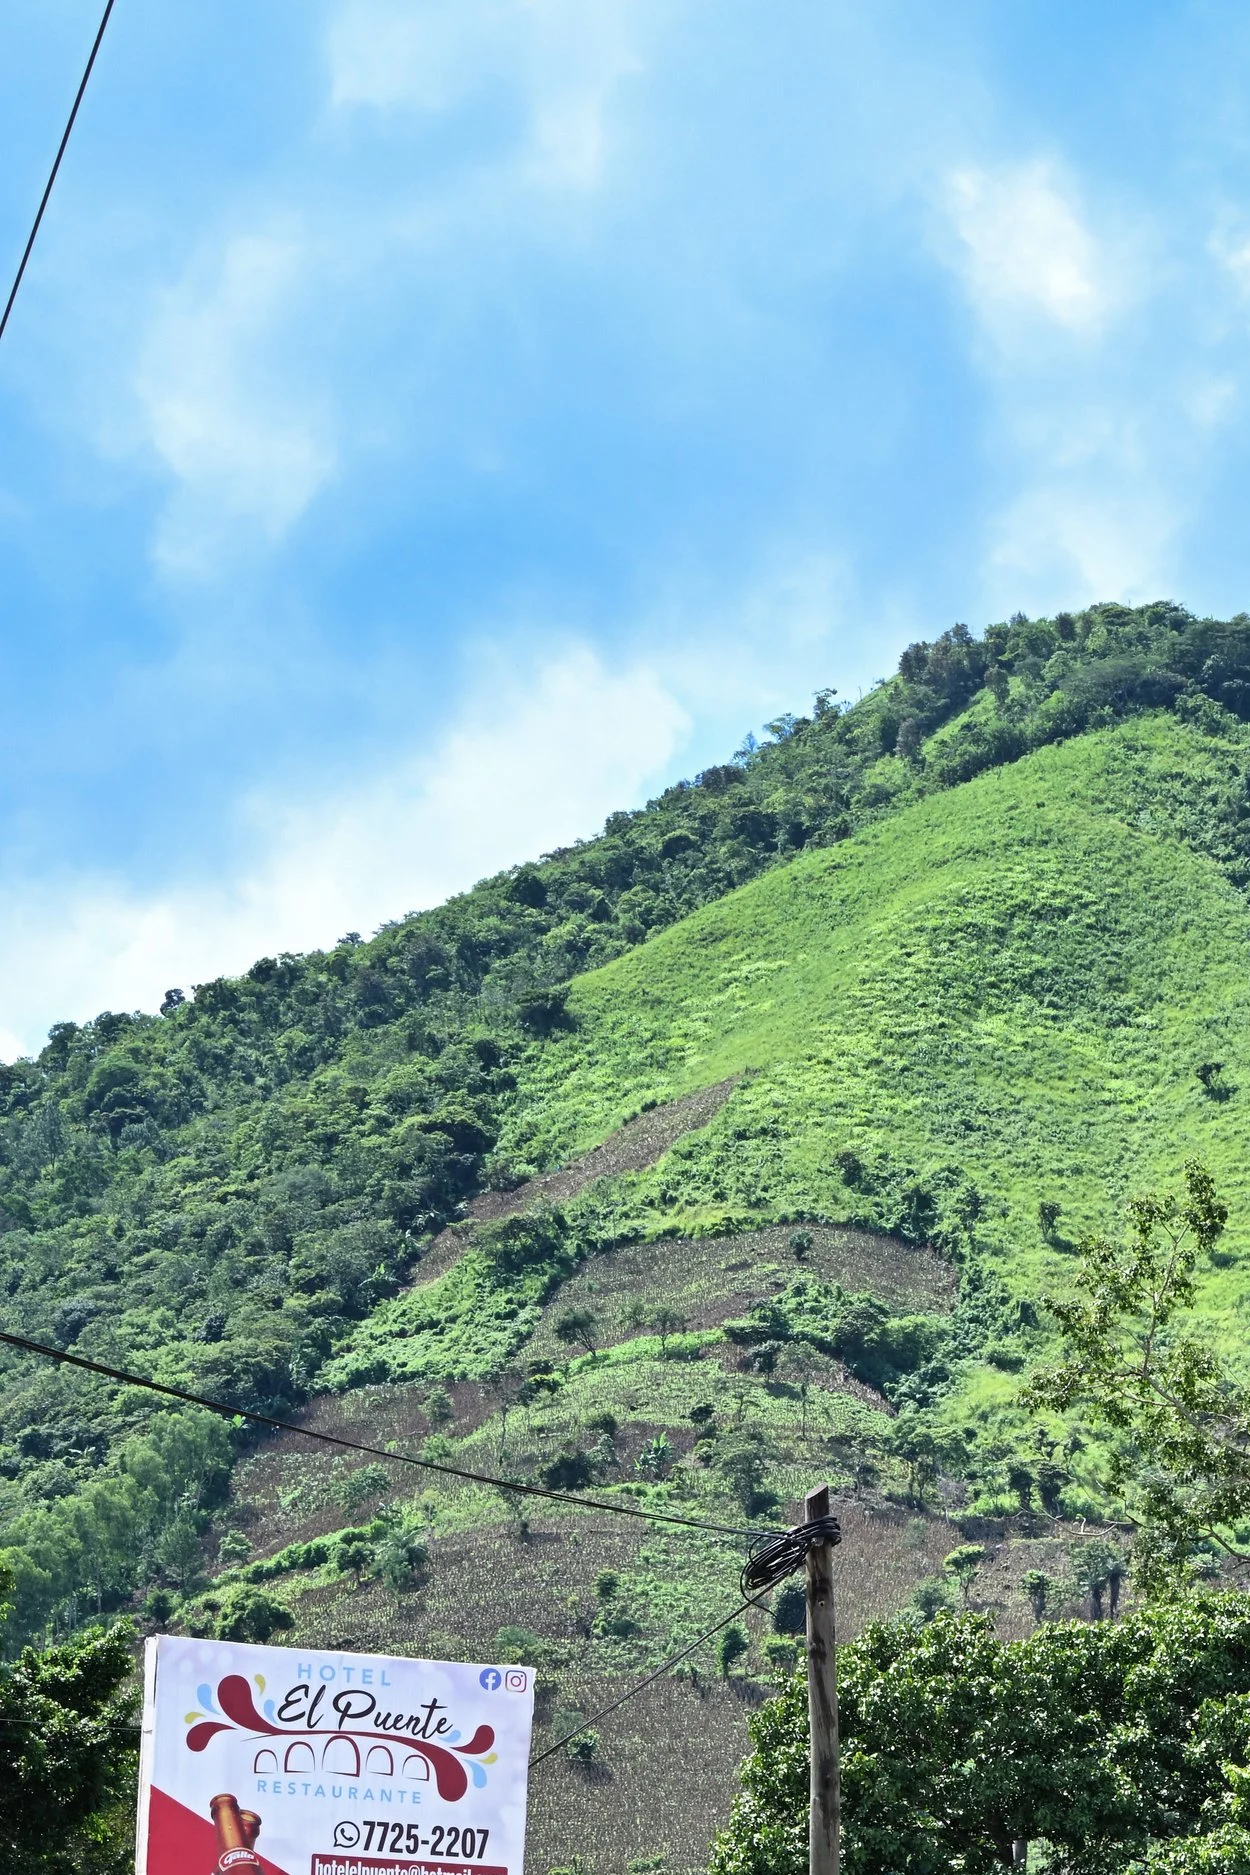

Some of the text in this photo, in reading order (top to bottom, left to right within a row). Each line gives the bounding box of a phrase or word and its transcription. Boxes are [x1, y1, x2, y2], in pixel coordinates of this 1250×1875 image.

[298, 1663, 391, 1686] HOTEL
[277, 1684, 453, 1739] El Puente
[258, 1779, 421, 1804] RESTAURANTE
[363, 1821, 489, 1859] 7725-2207
